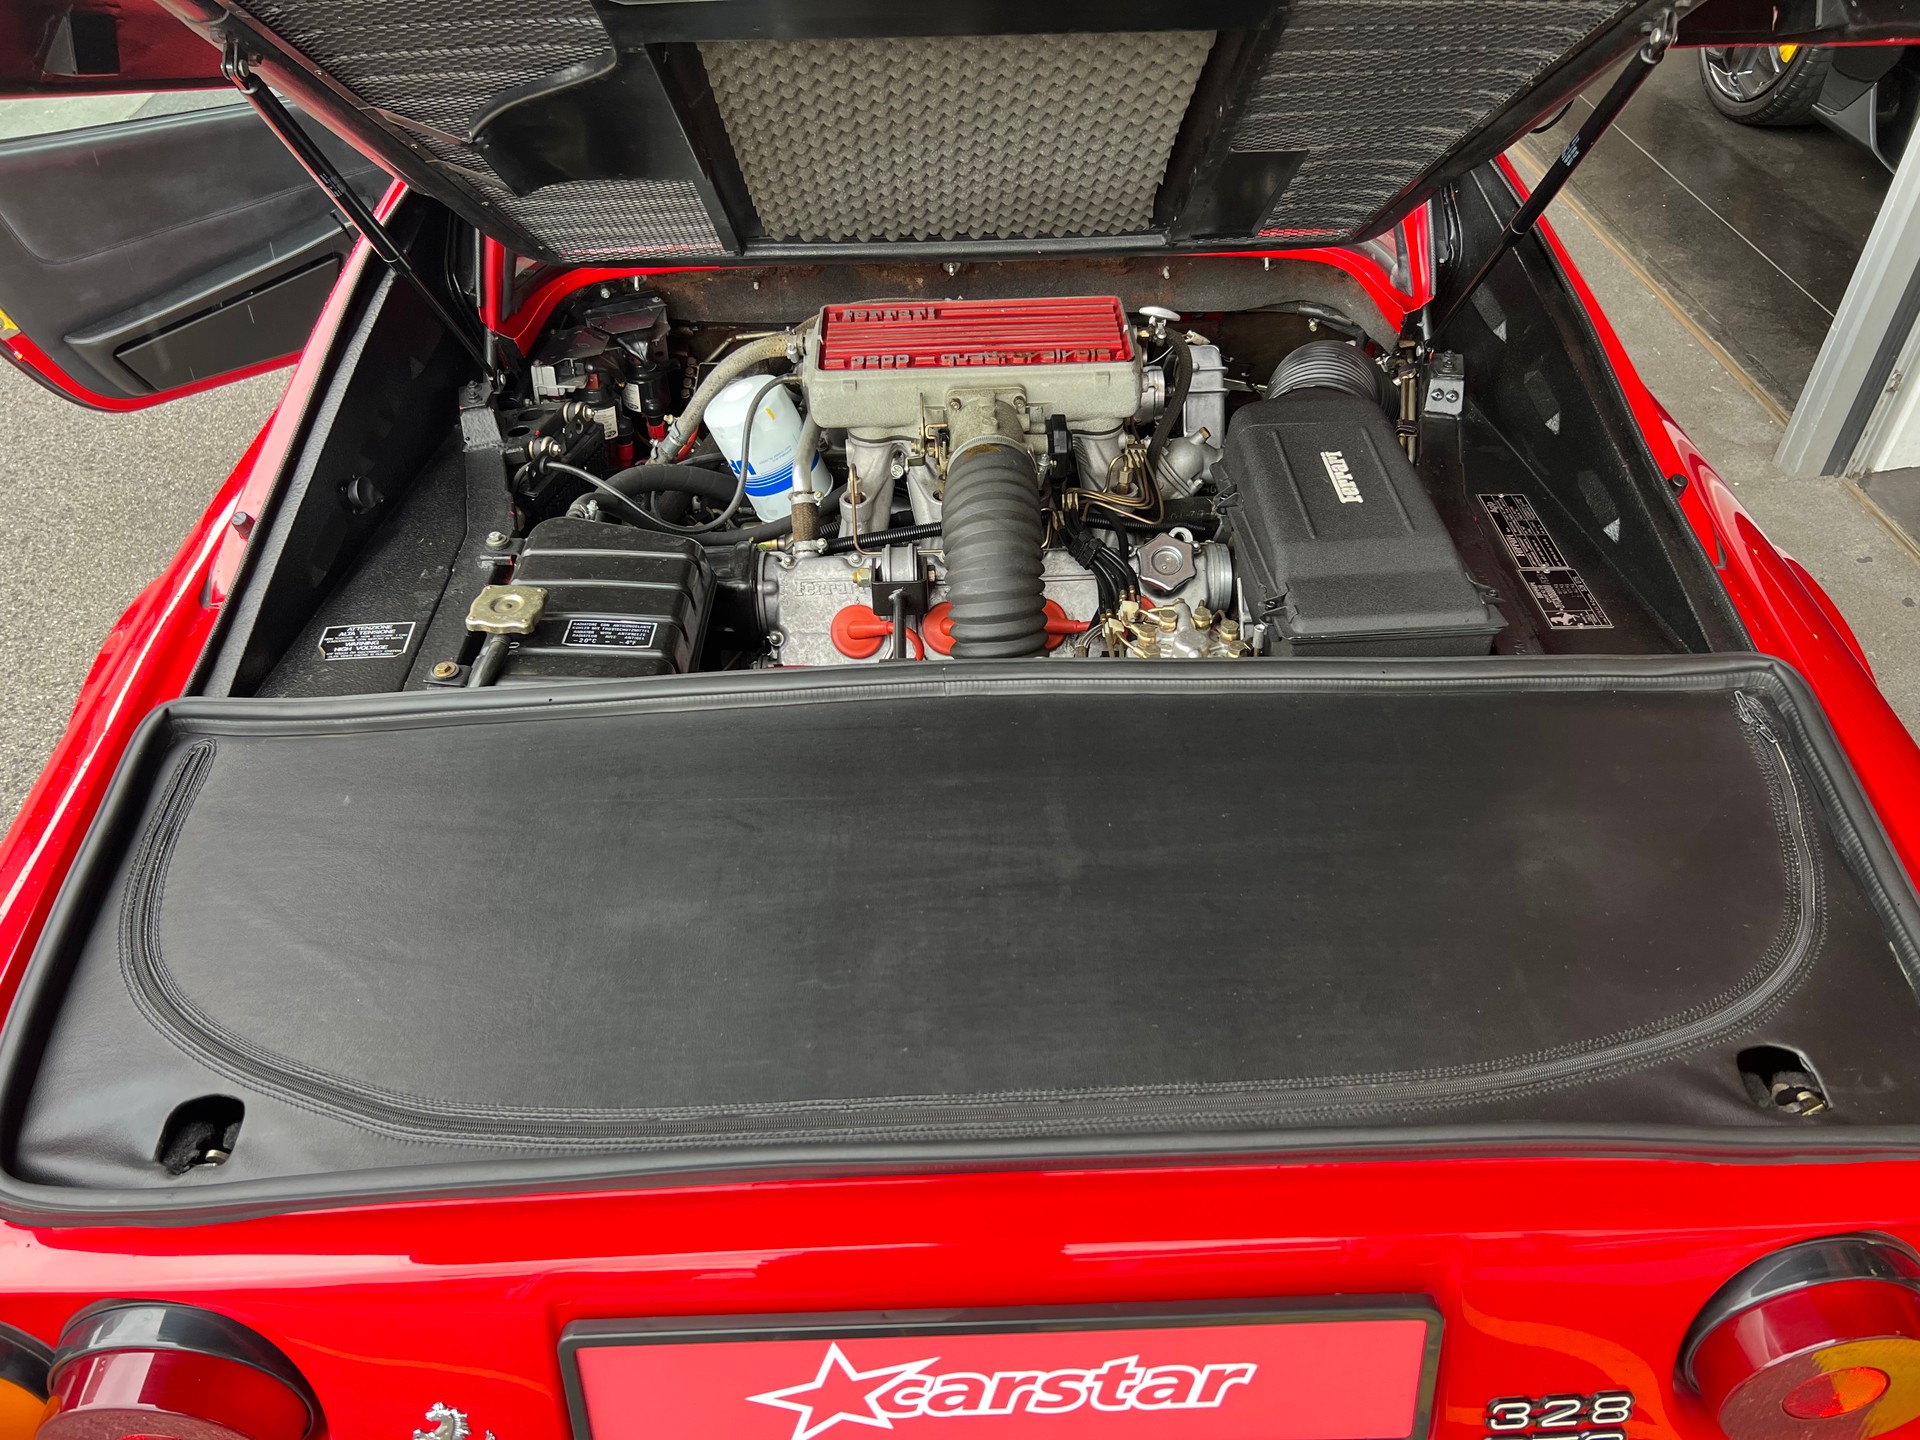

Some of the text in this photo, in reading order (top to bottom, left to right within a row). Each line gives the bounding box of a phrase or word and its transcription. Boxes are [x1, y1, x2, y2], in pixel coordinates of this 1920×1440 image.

[347, 624, 393, 632] ATTENZIONE
[885, 1354, 1258, 1419] carstar
[1489, 1394, 1633, 1431] 328
